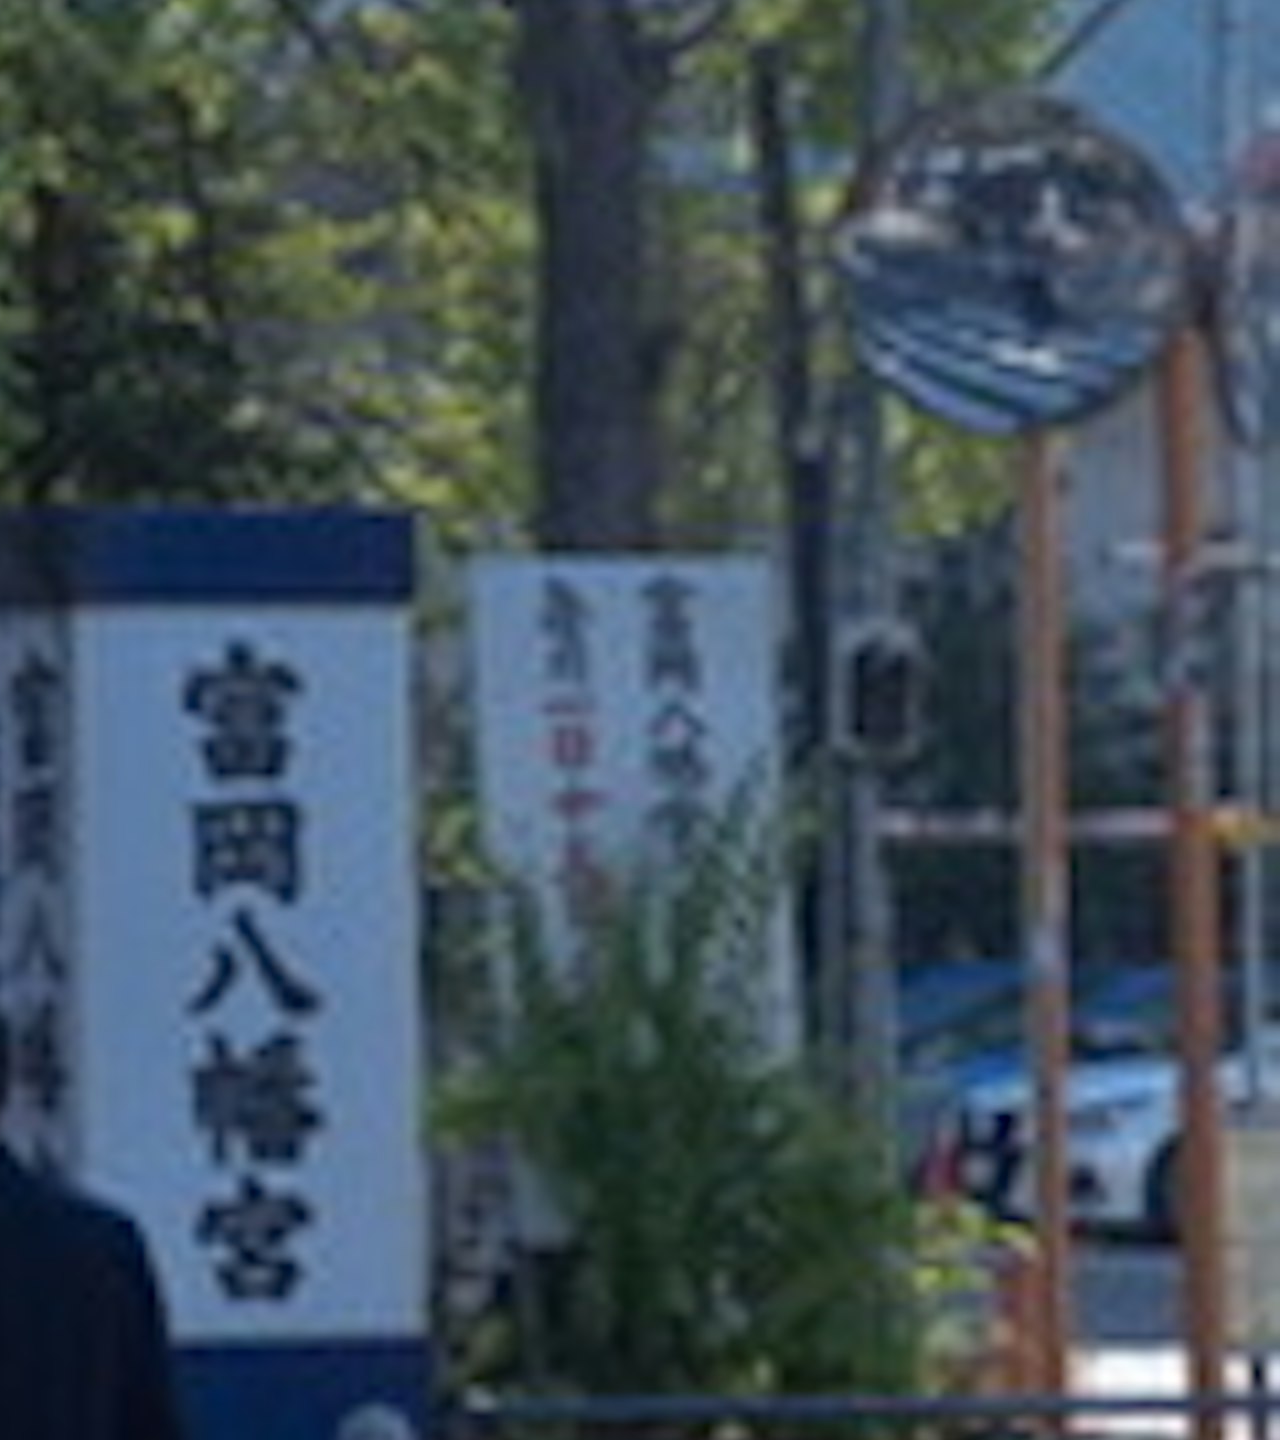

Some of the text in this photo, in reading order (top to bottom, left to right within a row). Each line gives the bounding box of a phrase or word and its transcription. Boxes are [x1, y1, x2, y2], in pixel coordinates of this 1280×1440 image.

[181, 638, 324, 1303] 富岡八幡宮
